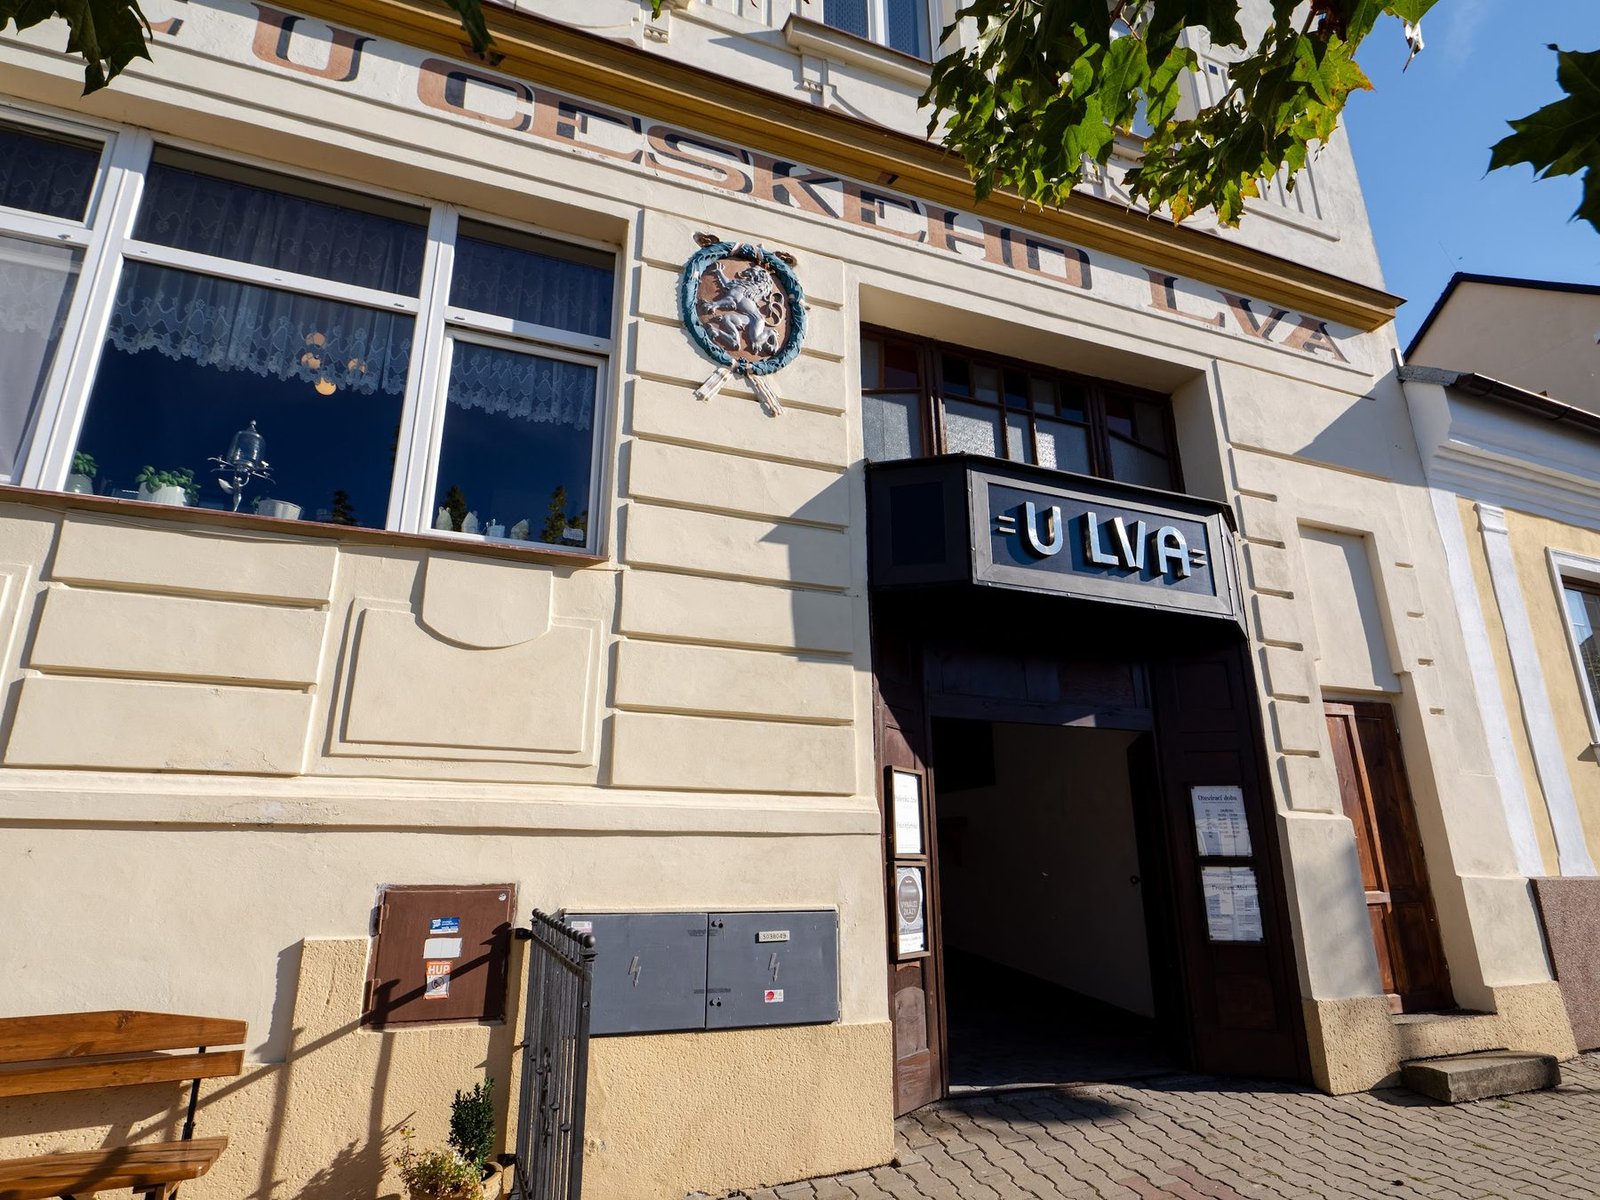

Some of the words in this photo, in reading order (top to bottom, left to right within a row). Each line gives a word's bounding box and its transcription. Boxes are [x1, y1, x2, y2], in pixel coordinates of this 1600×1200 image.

[250, 1, 377, 82] U
[1141, 266, 1351, 364] LVA
[1020, 501, 1064, 556] U
[1082, 511, 1192, 578] LVA
[428, 965, 450, 975] HUP
